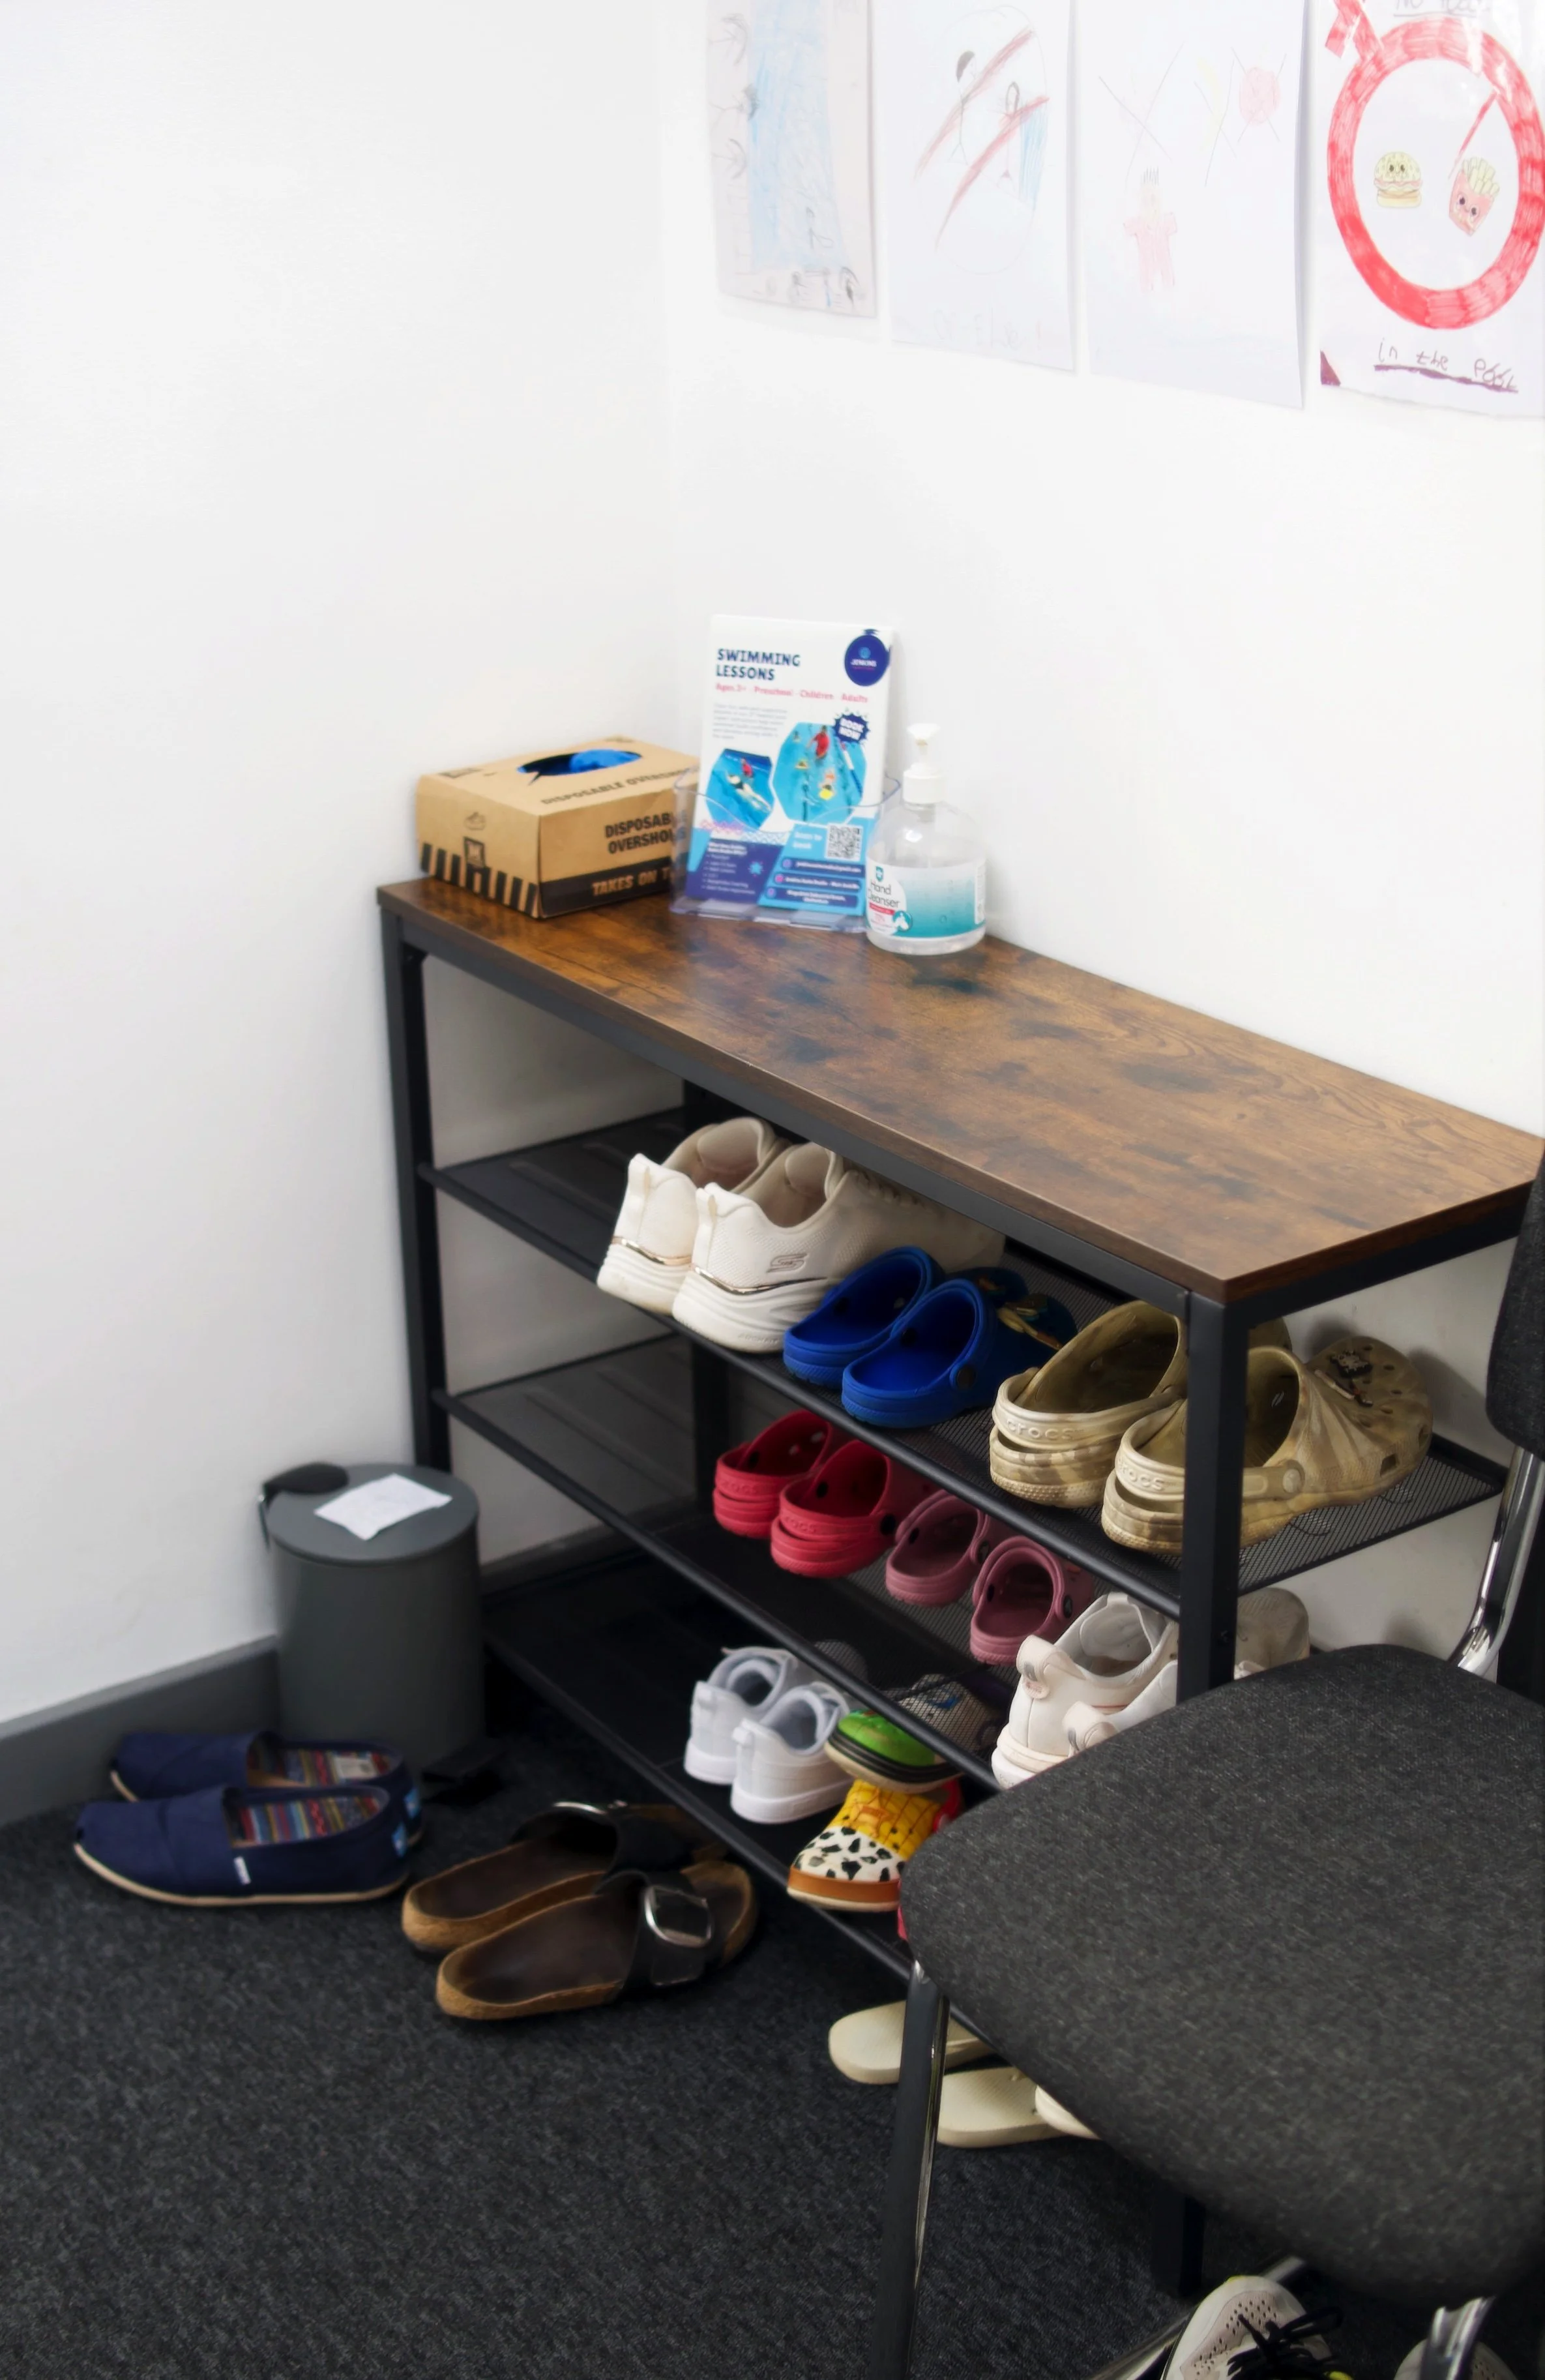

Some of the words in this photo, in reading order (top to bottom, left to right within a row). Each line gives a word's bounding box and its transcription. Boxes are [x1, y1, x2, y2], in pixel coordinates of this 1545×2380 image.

[1416, 350, 1449, 371] the
[717, 648, 801, 666] SWIMMING
[716, 664, 775, 681] LESSONS
[540, 781, 624, 805] DISPOSABLE
[592, 875, 634, 897] TAKES
[638, 869, 657, 887] ON
[870, 882, 892, 896] Hand
[1007, 1419, 1074, 1440] crocs
